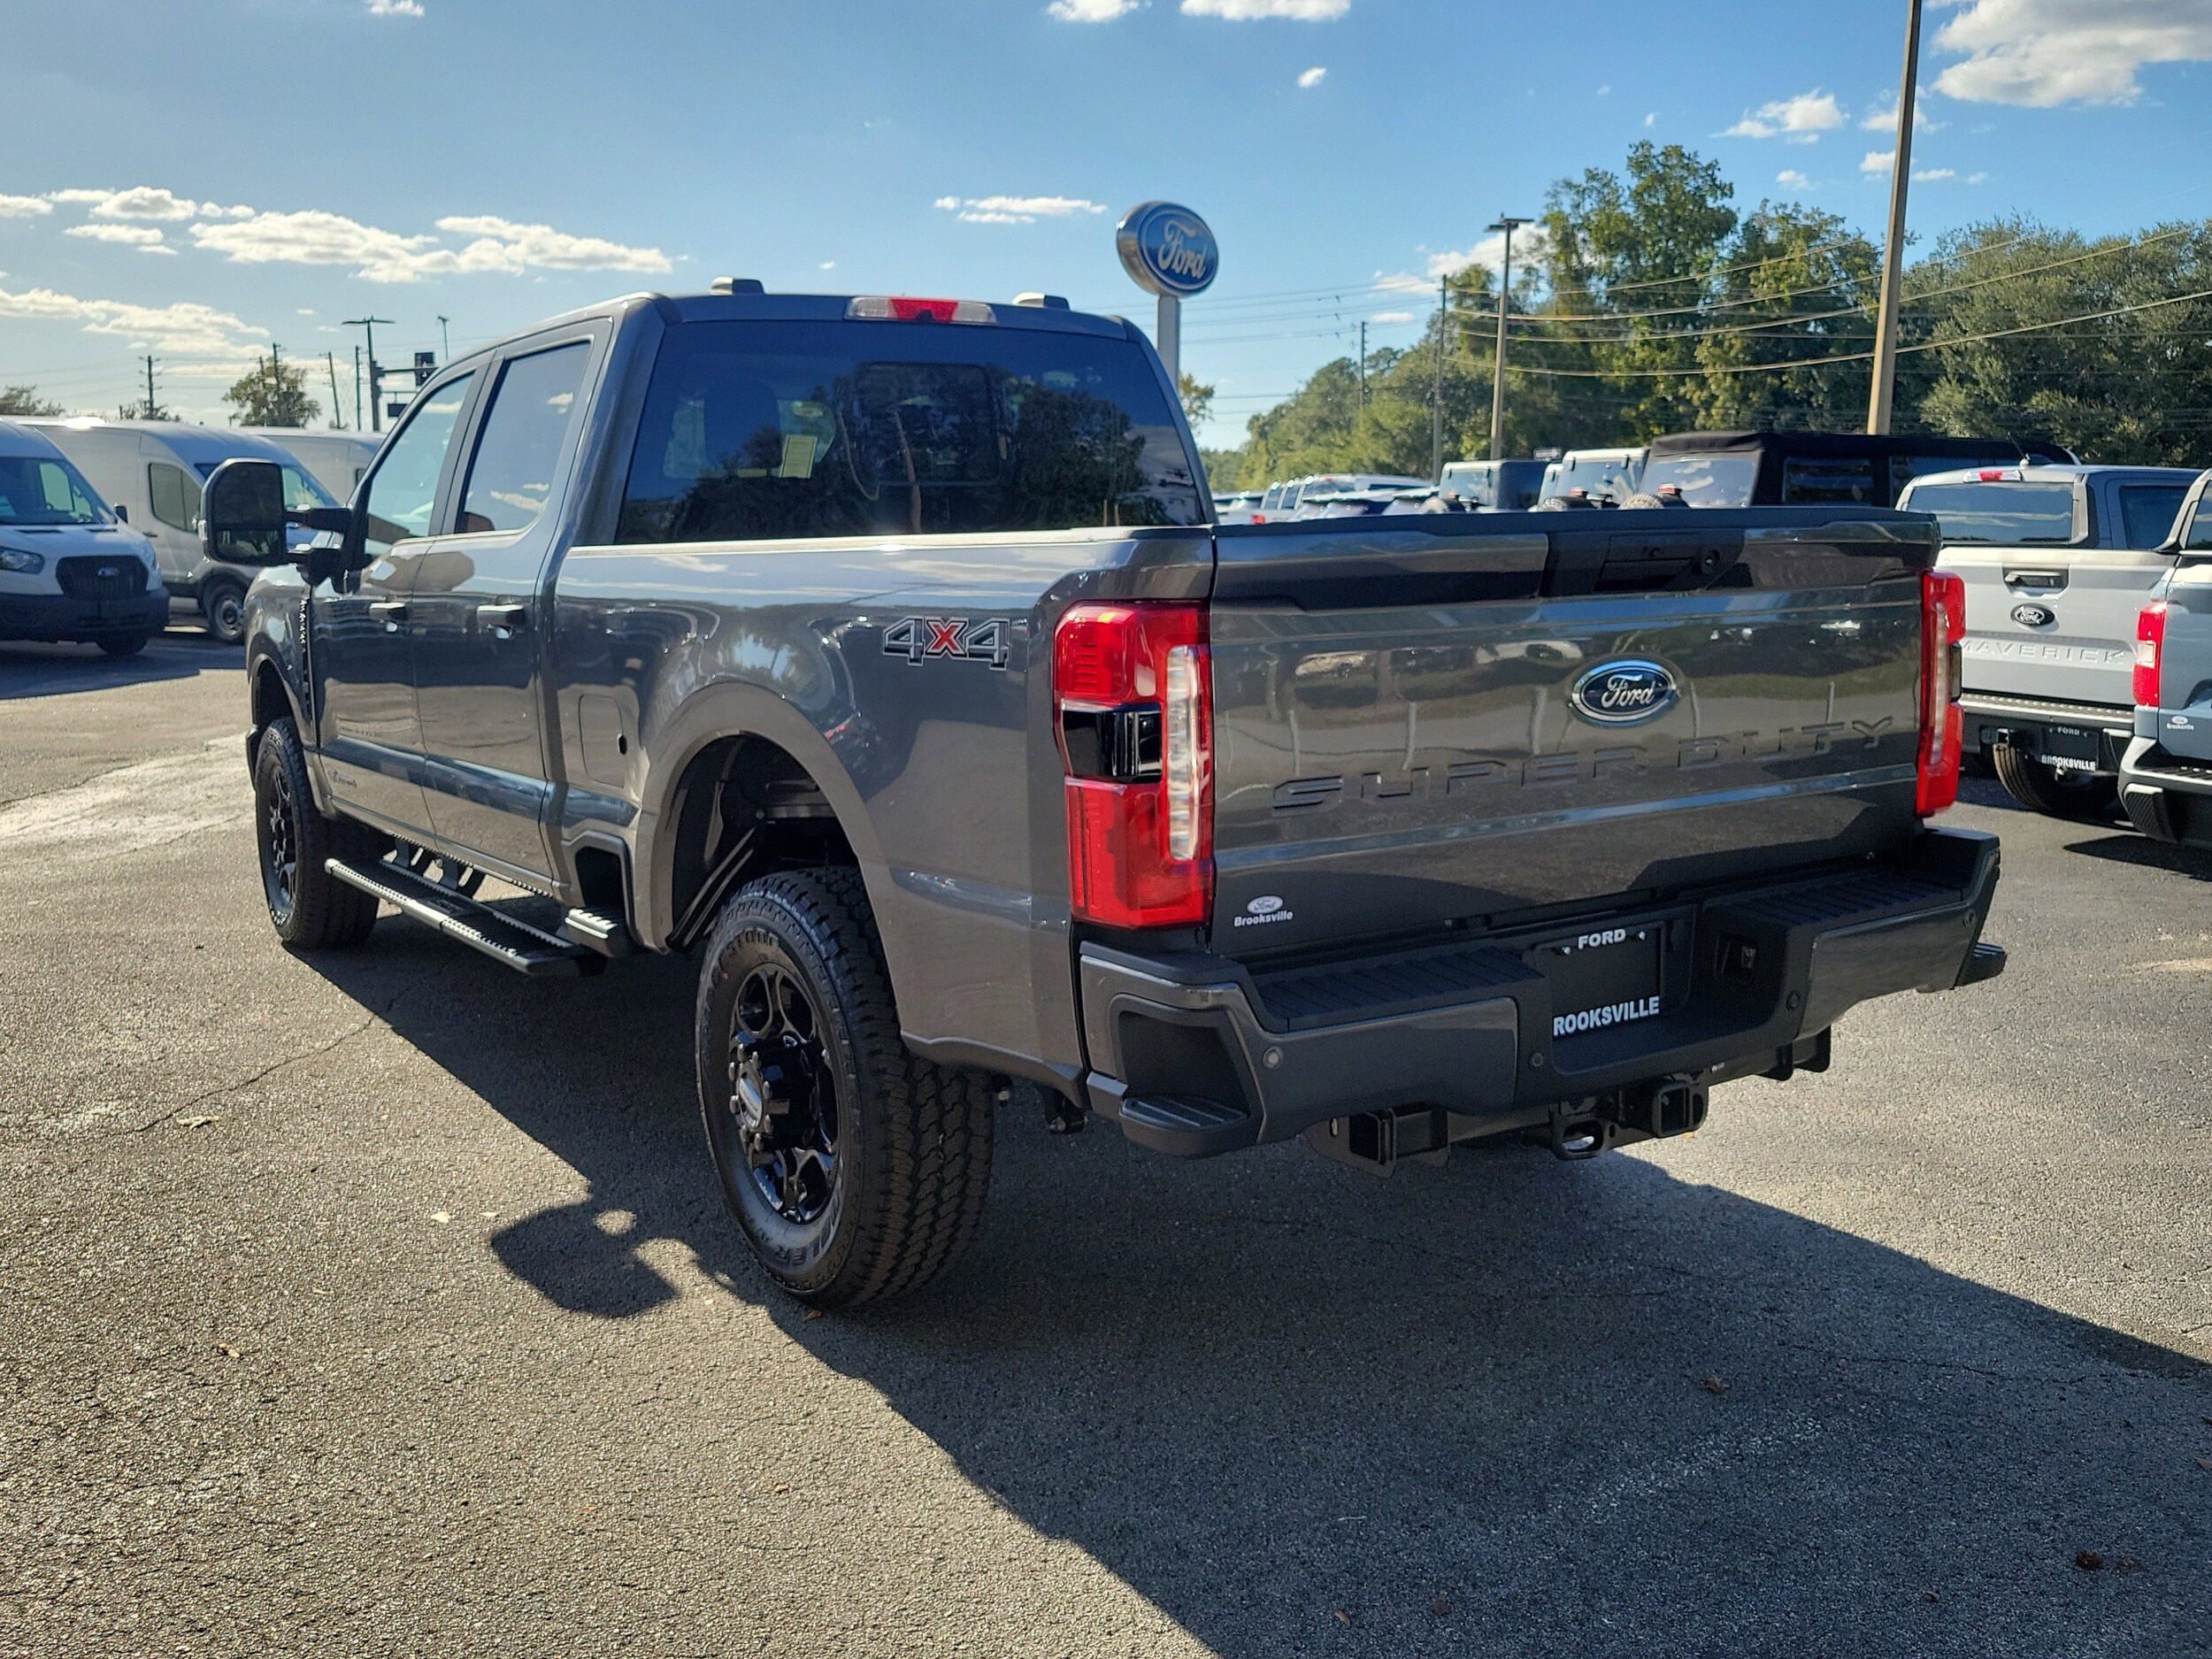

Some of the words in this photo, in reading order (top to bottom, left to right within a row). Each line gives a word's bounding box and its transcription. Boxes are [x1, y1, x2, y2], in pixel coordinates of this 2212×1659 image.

[1157, 220, 1207, 280] Ford
[1601, 673, 1656, 708] Ford
[1272, 745, 1648, 812] SUPER
[1677, 715, 1894, 770] DUTY
[1233, 910, 1294, 927] Brooksville
[1578, 928, 1626, 950] FORD
